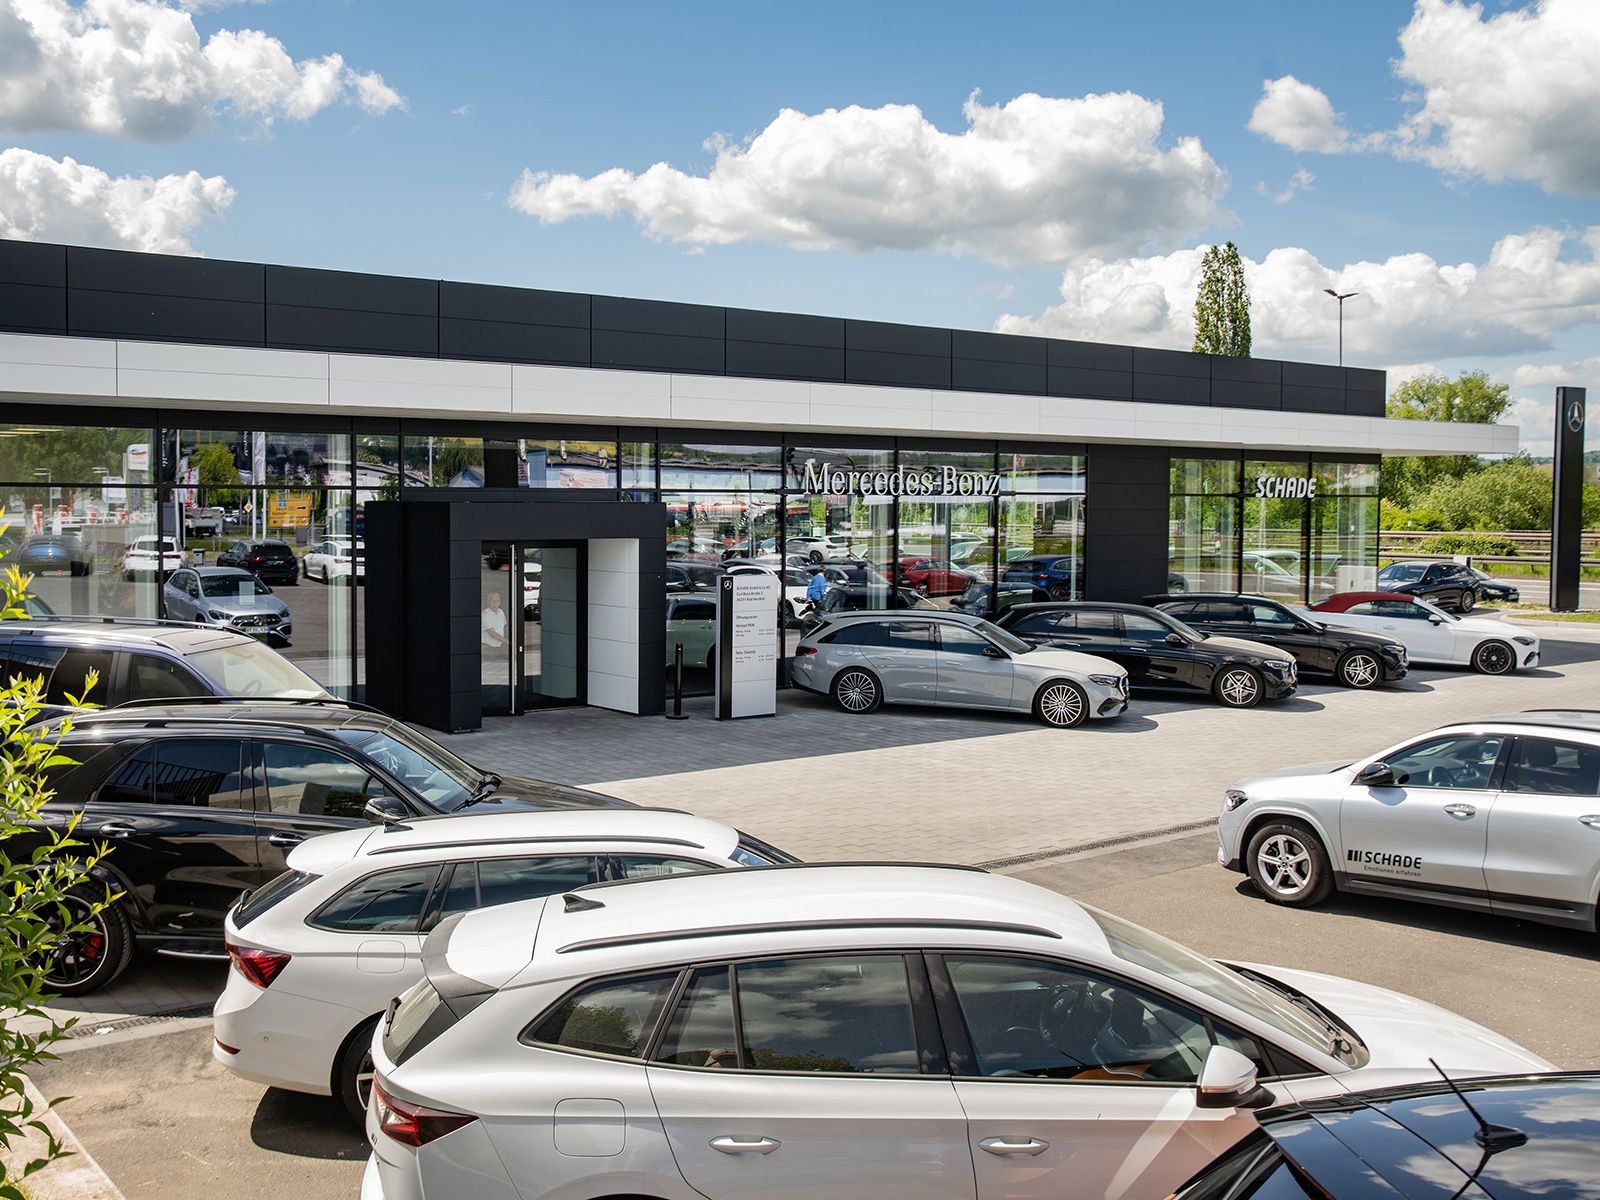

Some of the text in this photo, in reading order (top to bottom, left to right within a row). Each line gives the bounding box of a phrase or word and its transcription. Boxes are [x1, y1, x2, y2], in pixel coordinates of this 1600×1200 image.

[803, 460, 1001, 496] Mercedes-Benz
[1255, 477, 1317, 498] SCHADE
[1364, 851, 1422, 869] SCHADE
[1364, 865, 1422, 877] Emotionen erfahren
